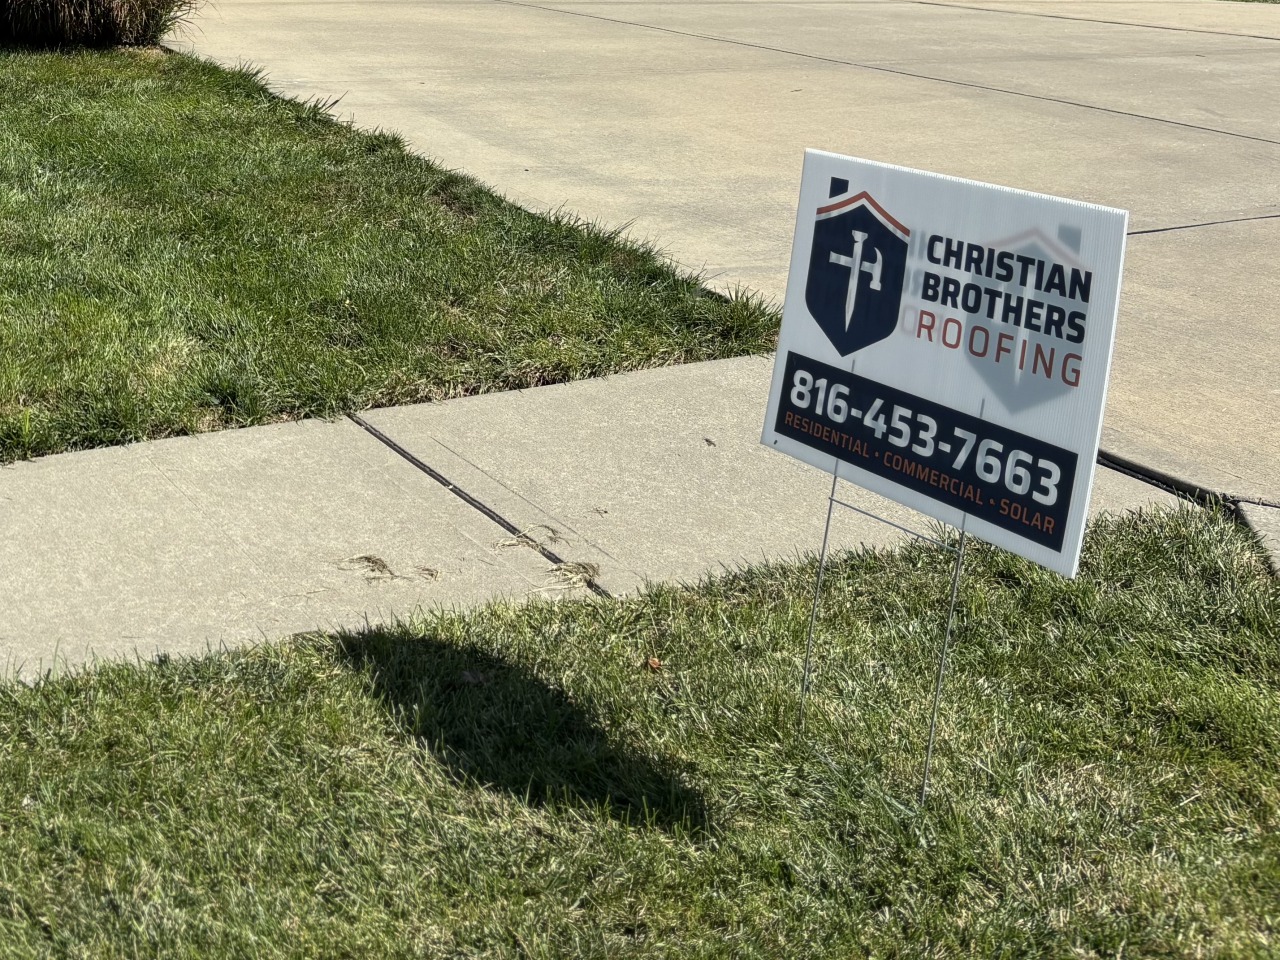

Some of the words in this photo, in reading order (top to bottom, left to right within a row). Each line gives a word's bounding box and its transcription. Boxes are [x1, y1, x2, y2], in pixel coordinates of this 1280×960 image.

[921, 271, 1087, 343] BROTHERS
[927, 234, 1093, 303] CHRISTIAN
[916, 310, 1083, 387] ROOFING
[785, 412, 870, 459] RESIDENTIAL
[883, 451, 984, 506] COMMERCIAL
[999, 499, 1056, 535] SOLAR
[790, 369, 1061, 506] 816-453-7663
